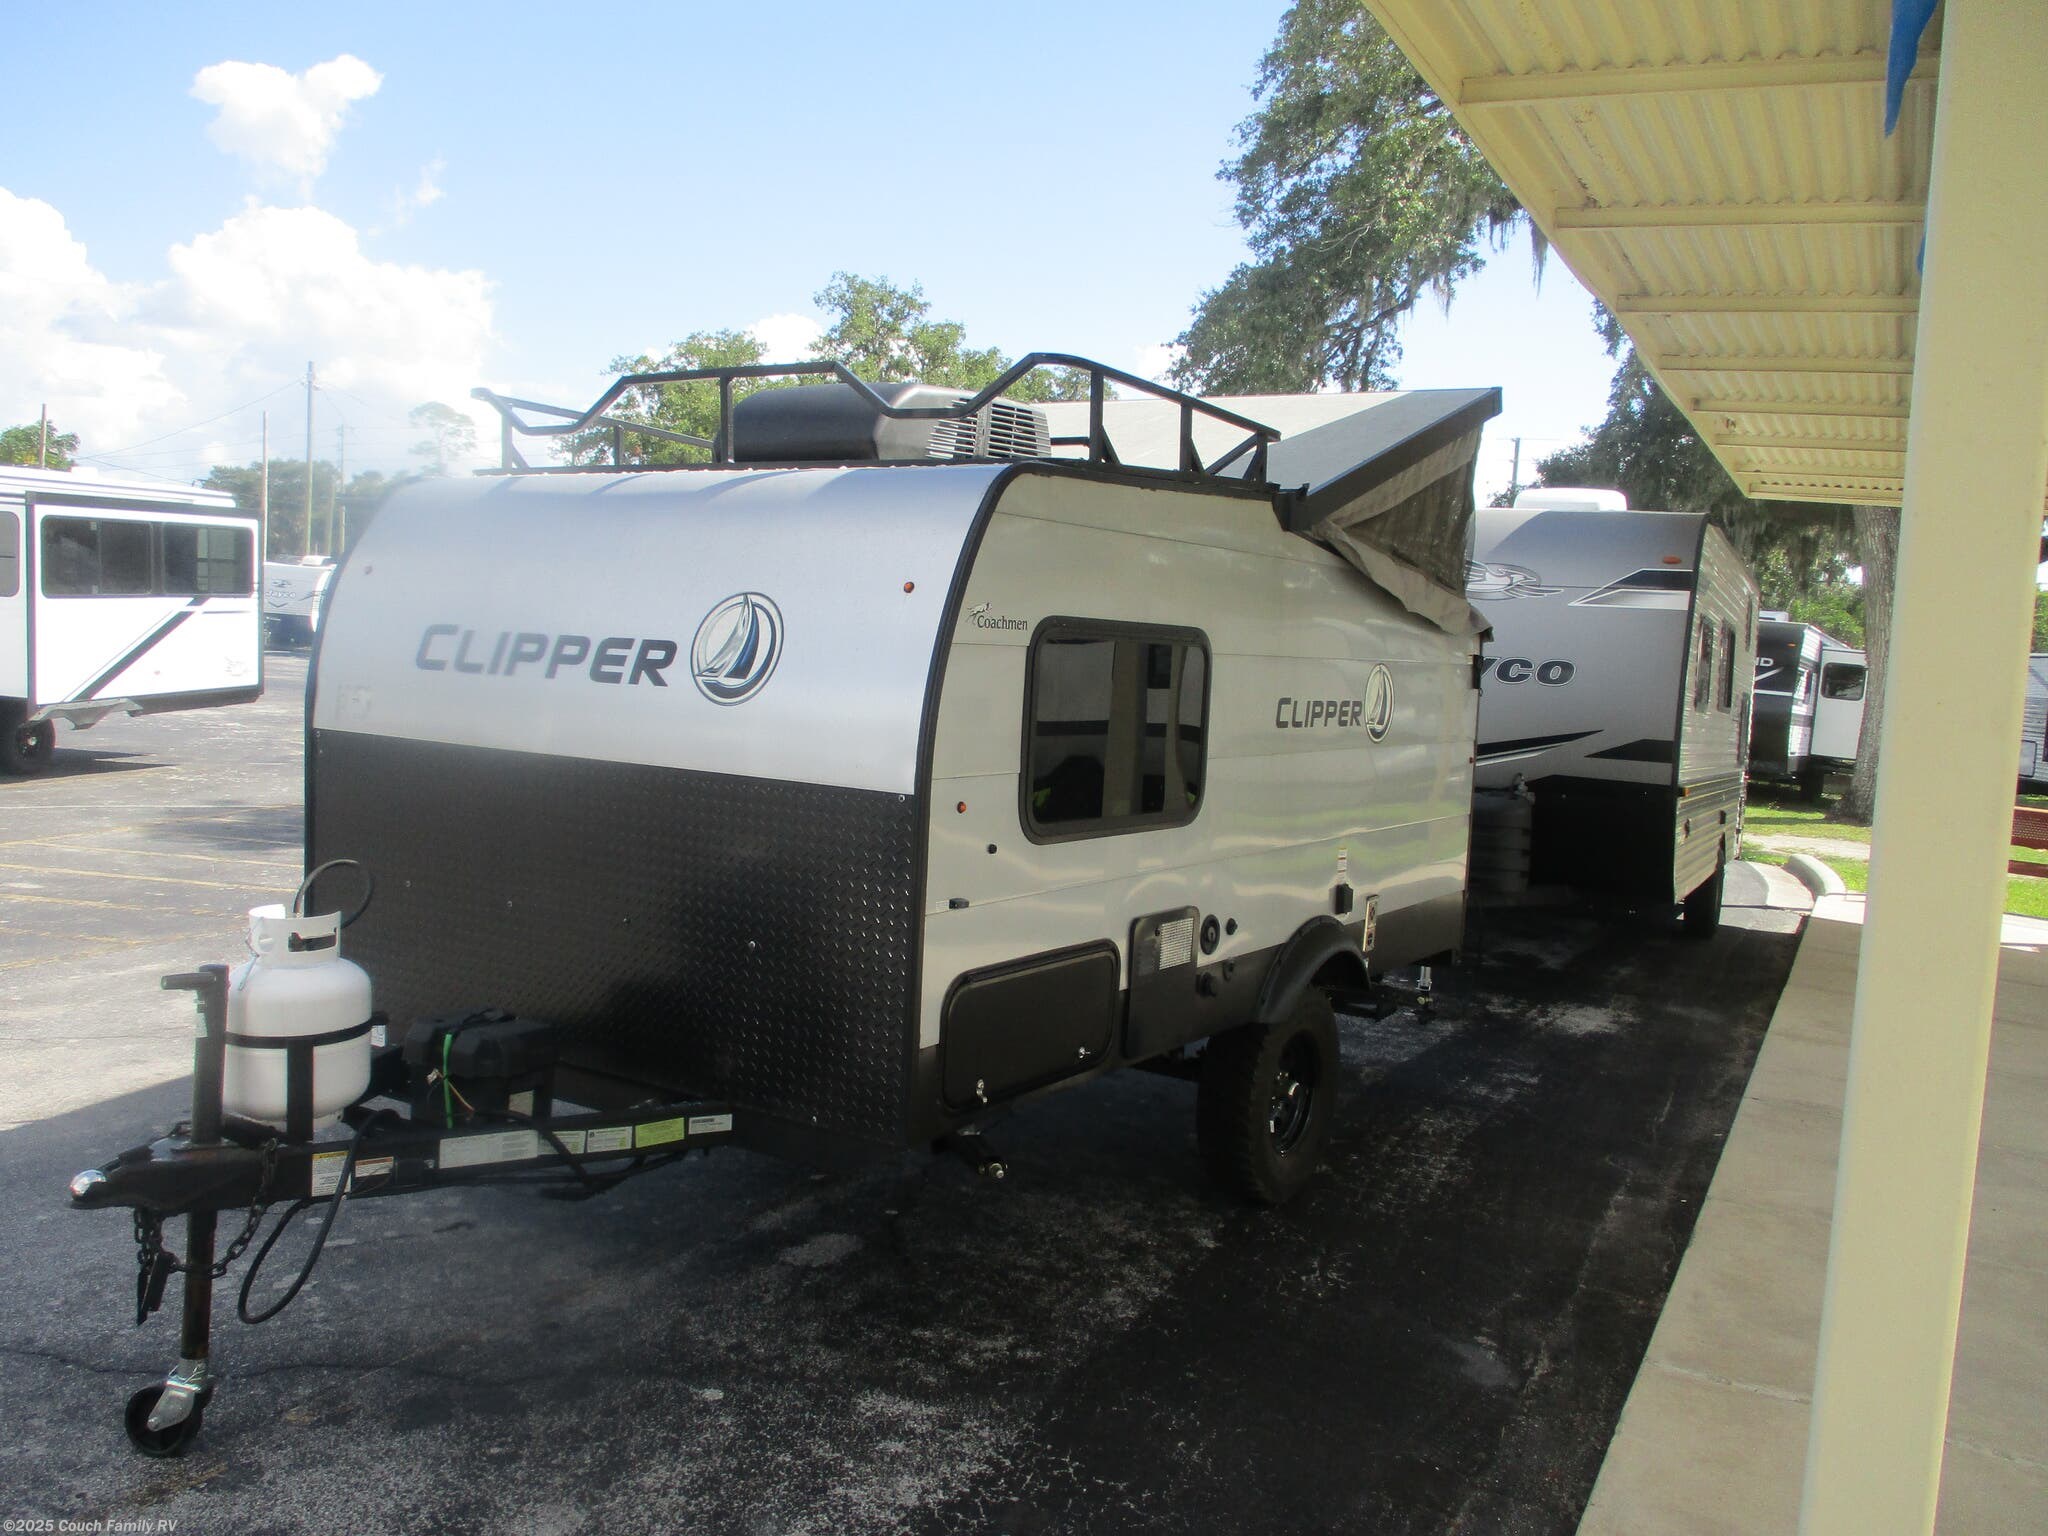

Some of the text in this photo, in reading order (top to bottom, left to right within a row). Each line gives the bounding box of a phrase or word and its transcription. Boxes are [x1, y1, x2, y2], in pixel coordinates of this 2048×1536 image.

[977, 615, 1028, 630] Coachmen
[415, 623, 678, 687] CLIPPER
[1276, 697, 1363, 728] CLIPPER
